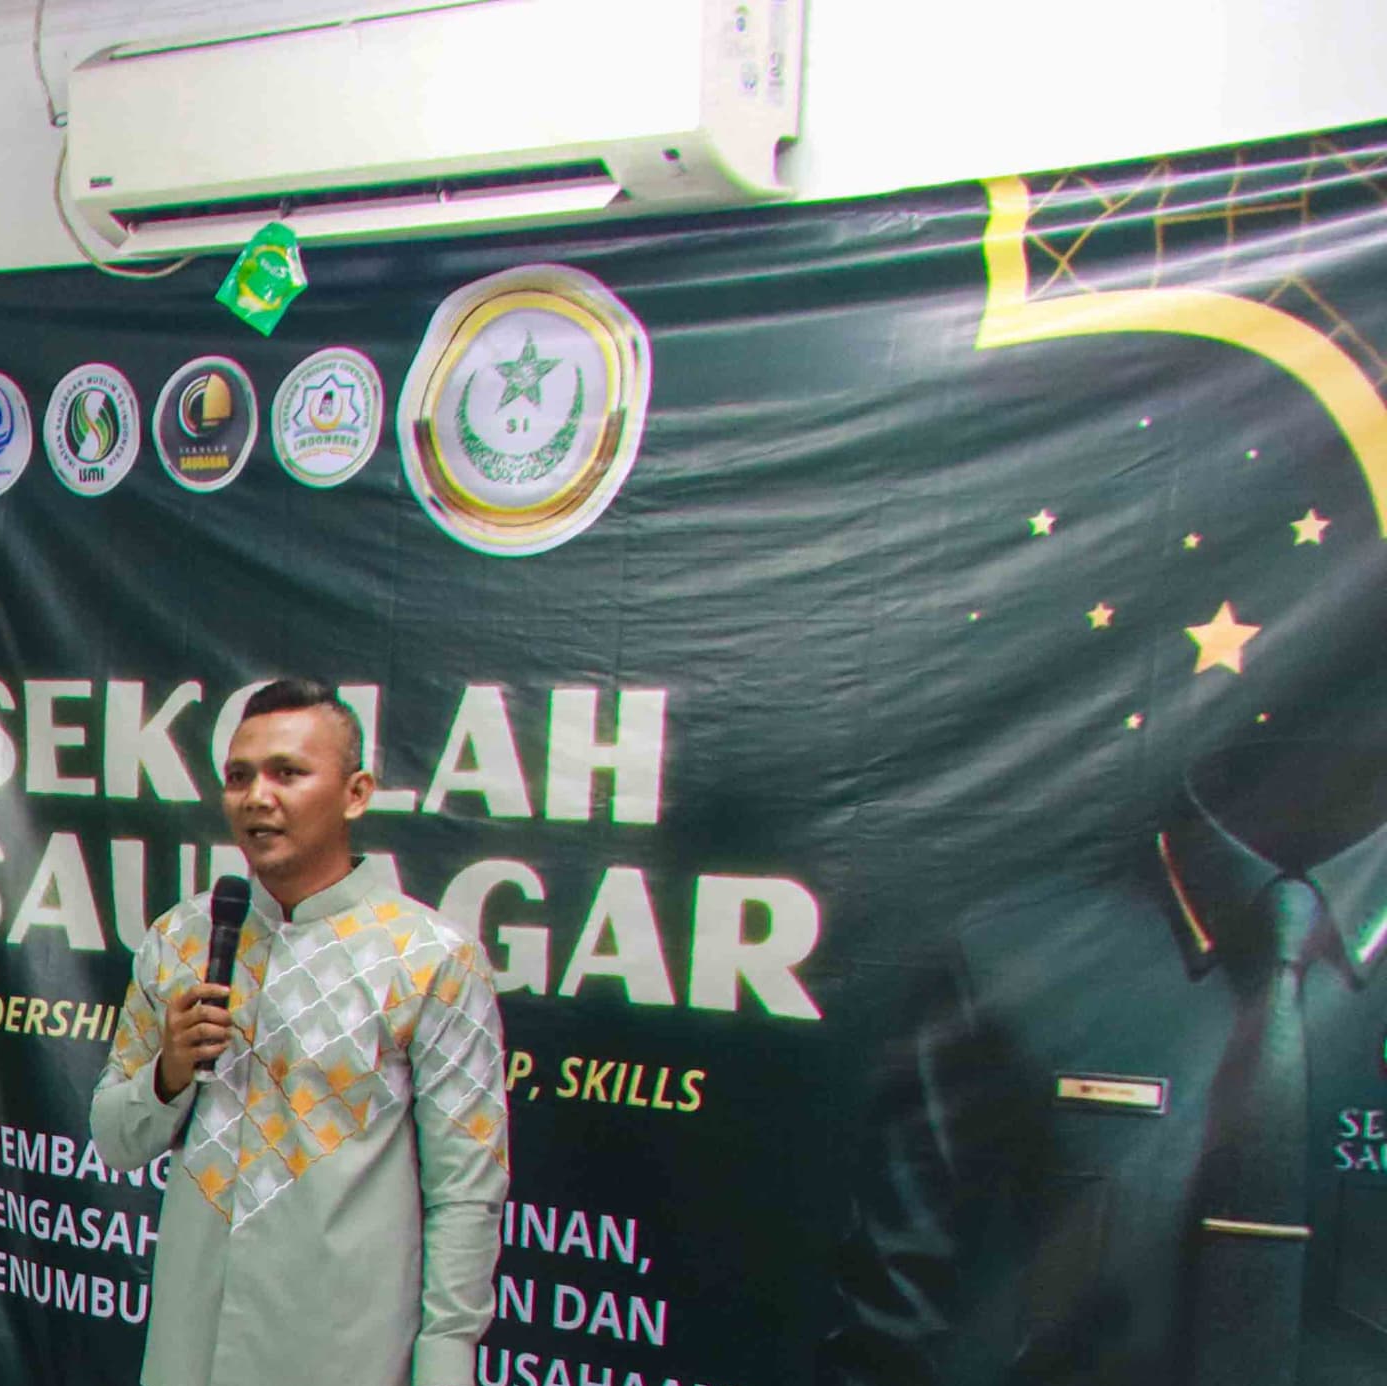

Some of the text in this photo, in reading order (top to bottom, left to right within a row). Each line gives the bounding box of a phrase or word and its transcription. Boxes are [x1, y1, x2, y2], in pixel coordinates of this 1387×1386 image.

[555, 1055, 707, 1113] SKILLS
[1338, 1107, 1385, 1140] SE
[502, 1200, 652, 1275] INAN,
[552, 1283, 668, 1347] DAN
